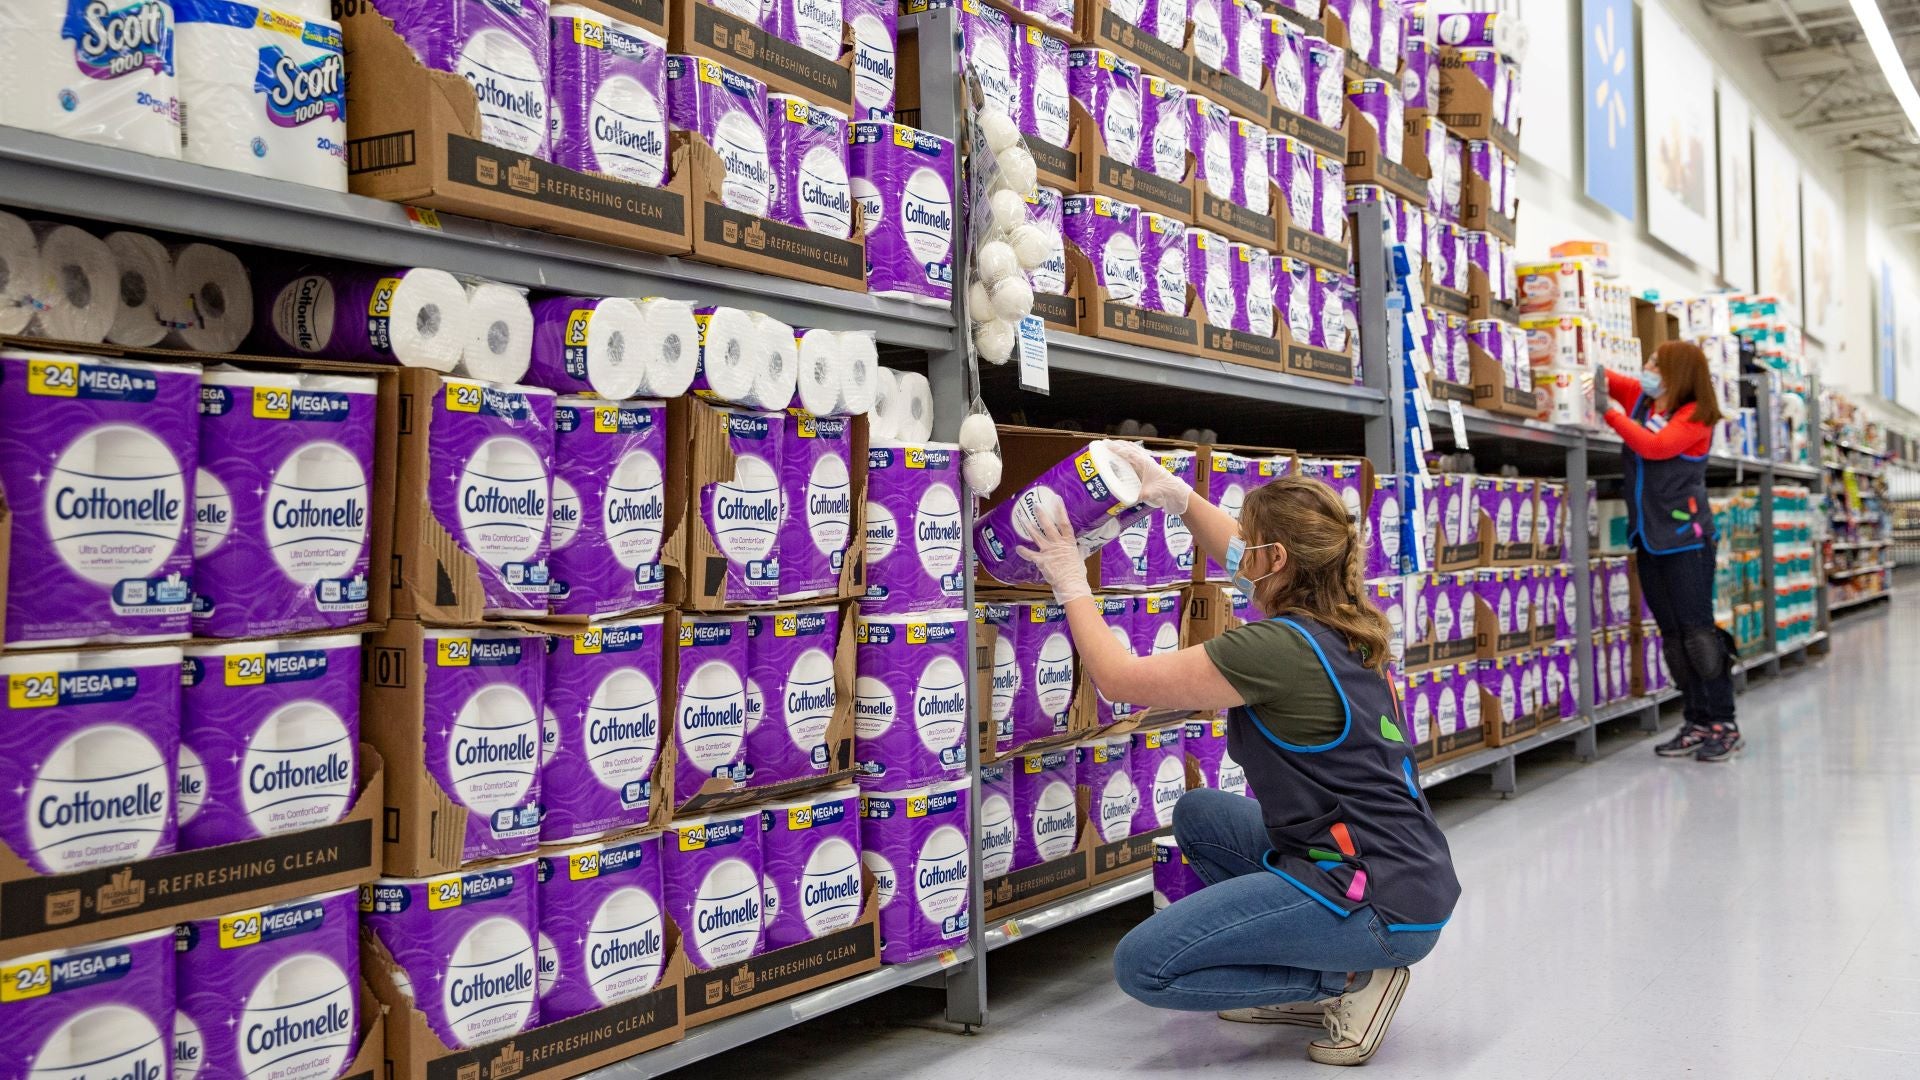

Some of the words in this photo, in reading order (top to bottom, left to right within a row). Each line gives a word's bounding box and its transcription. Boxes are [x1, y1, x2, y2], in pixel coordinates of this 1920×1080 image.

[82, 1, 161, 55] Scott
[584, 23, 602, 41] 24
[603, 31, 631, 52] MEGA
[1032, 31, 1041, 43] 24
[109, 51, 144, 76] 1000
[707, 64, 721, 80] 24
[759, 47, 811, 76] REFRESHING
[812, 70, 839, 90] CLEAN
[855, 49, 894, 80] ottonelle
[272, 55, 341, 106] Scott
[137, 92, 151, 105] 20
[295, 100, 324, 122] 1000
[794, 104, 808, 120] 24
[595, 115, 662, 157] Cottonelle
[857, 126, 878, 134] MEGA
[901, 130, 913, 143] 24
[317, 138, 331, 150] 20
[1047, 154, 1067, 170] CLEAN
[547, 179, 622, 209] REFRESHING
[627, 199, 662, 220] CLEAN
[802, 181, 850, 214] Cottonelle
[1064, 199, 1082, 208] MEGA
[905, 200, 951, 232] Cottonelle
[770, 236, 821, 260] REFRESHING
[823, 252, 849, 267] CLEAN
[374, 288, 393, 314] 24
[1048, 304, 1067, 318] CLEAN
[377, 318, 389, 350] MEGA
[570, 319, 588, 342] 24
[575, 347, 585, 377] MEGA
[46, 366, 76, 387] 24
[80, 371, 133, 391] MEGA
[266, 391, 289, 411] 24
[291, 395, 331, 412] MEGA
[459, 388, 478, 405] 24
[482, 393, 510, 411] MEGA
[603, 411, 617, 425] 24
[729, 418, 756, 431] MEGA
[804, 419, 816, 432] 24
[868, 451, 889, 459] MEGA
[912, 451, 925, 463] 24
[1080, 459, 1096, 477] 24
[1093, 475, 1108, 497] MEGA
[55, 486, 179, 521] Cottonelle
[465, 485, 545, 517] Cottonelle
[608, 495, 663, 525] Cottonelle
[717, 496, 778, 522] Cottonelle
[810, 493, 850, 516] Cottonelle
[272, 498, 364, 529] Cottonelle
[479, 533, 492, 542] Ultra
[493, 533, 530, 543] ComfortCare
[918, 520, 961, 542] Cottonelle
[78, 545, 98, 554] Ultra
[100, 545, 154, 555] ComfortCare
[975, 610, 985, 621] 24
[1035, 607, 1045, 618] 24
[1191, 601, 1205, 617] 01
[679, 628, 693, 639] 24
[694, 627, 719, 639] MEGA
[782, 617, 795, 631] 24
[796, 616, 817, 630] MEGA
[869, 626, 890, 634] MEGA
[913, 627, 926, 639] 24
[926, 627, 945, 638] MEGA
[448, 642, 468, 658] 24
[471, 643, 507, 657] MEGA
[584, 632, 600, 647] 24
[602, 632, 630, 645] MEGA
[238, 659, 263, 676] 24
[266, 657, 307, 674] MEGA
[378, 650, 401, 684] 01
[1039, 666, 1072, 686] Cottonelle
[26, 677, 56, 699] 24
[60, 674, 113, 694] MEGA
[788, 687, 835, 714] Cottonelle
[918, 693, 964, 717] Cottonelle
[683, 702, 743, 731] Cottonelle
[589, 712, 656, 745] Cottonelle
[455, 733, 535, 766] Cottonelle
[249, 753, 349, 793] Cottonelle
[1031, 757, 1041, 768] 24
[470, 784, 482, 792] Ultra
[484, 780, 519, 791] ComfortCare
[38, 783, 164, 829] Cottonelle
[269, 809, 285, 821] Ultra
[286, 805, 329, 819] ComfortCare
[797, 810, 811, 824] 24
[812, 805, 834, 820] MEGA
[869, 801, 890, 809] MEGA
[914, 798, 927, 812] 24
[927, 797, 947, 809] MEGA
[706, 825, 730, 841] MEGA
[1036, 811, 1075, 836] Cottonelle
[981, 828, 1012, 850] ottonelle
[158, 860, 276, 894] REFRESHING
[283, 846, 339, 871] CLEAN
[579, 855, 597, 873] 24
[599, 851, 628, 868] MEGA
[918, 861, 967, 890] Cottonelle
[375, 889, 404, 899] MEGA
[439, 885, 460, 902] 24
[463, 877, 497, 895] MEGA
[804, 873, 859, 906] Cottonelle
[232, 917, 259, 938] 24
[262, 911, 304, 932] MEGA
[698, 900, 759, 934] Cottonelle
[590, 930, 661, 970] Cottonelle
[17, 967, 47, 990] 24
[52, 956, 105, 981] MEGA
[760, 954, 823, 982] REFRESHING
[827, 942, 857, 962] CLEAN
[450, 967, 533, 1007] Cottonelle
[246, 1002, 349, 1055] Cottonelle
[532, 1026, 613, 1062] REFRESHING
[617, 1010, 655, 1034] CLEAN
